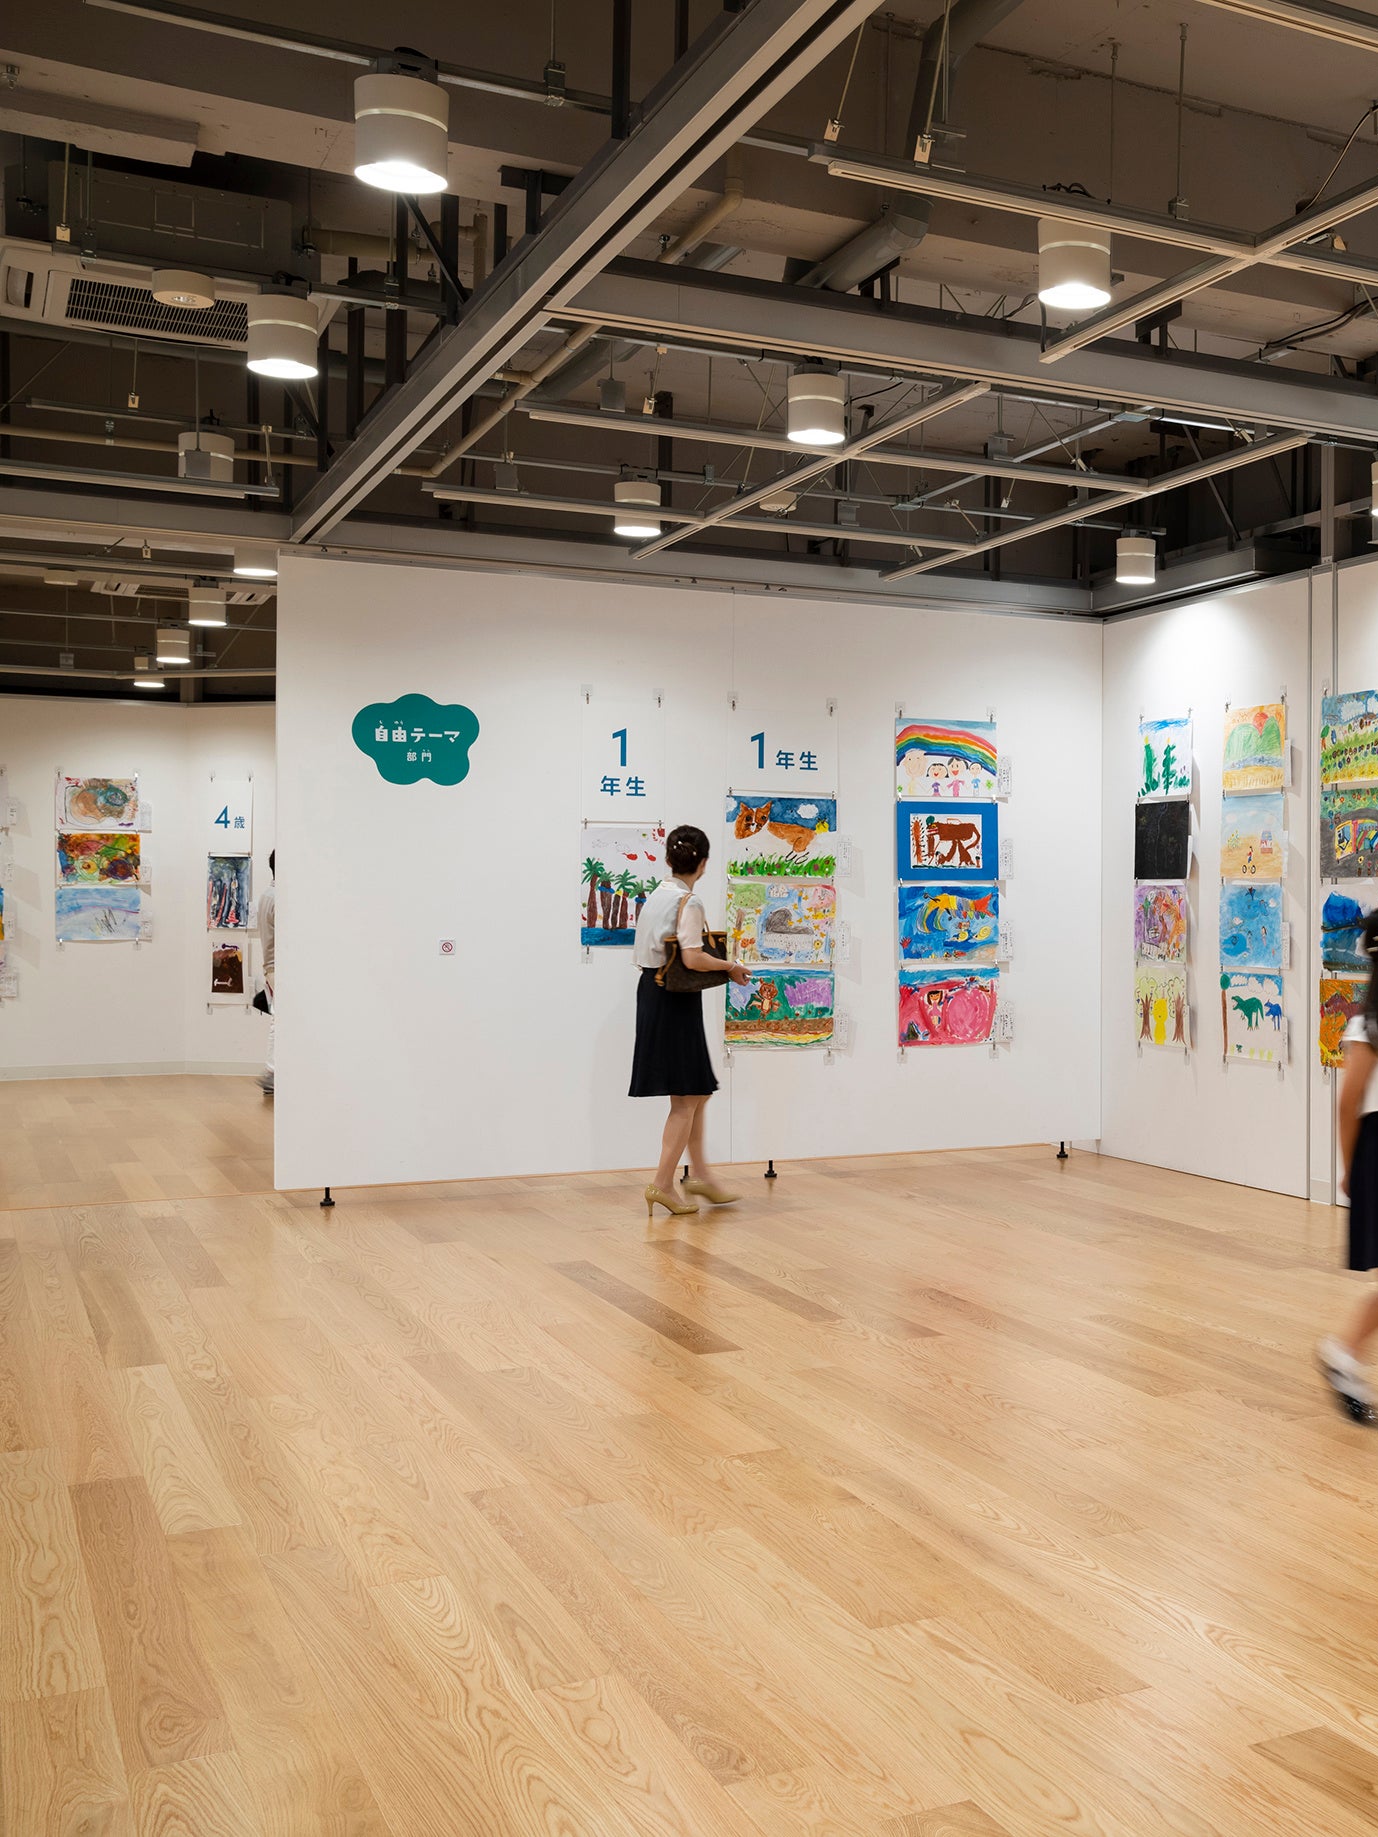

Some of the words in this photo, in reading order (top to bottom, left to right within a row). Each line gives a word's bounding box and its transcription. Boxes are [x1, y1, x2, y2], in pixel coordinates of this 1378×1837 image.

[375, 725, 460, 743] 自由テーマ
[407, 751, 432, 763] 部門
[611, 728, 627, 767] 1
[750, 731, 819, 771] 1年生
[600, 775, 646, 797] 年生
[214, 805, 246, 829] 4歳
